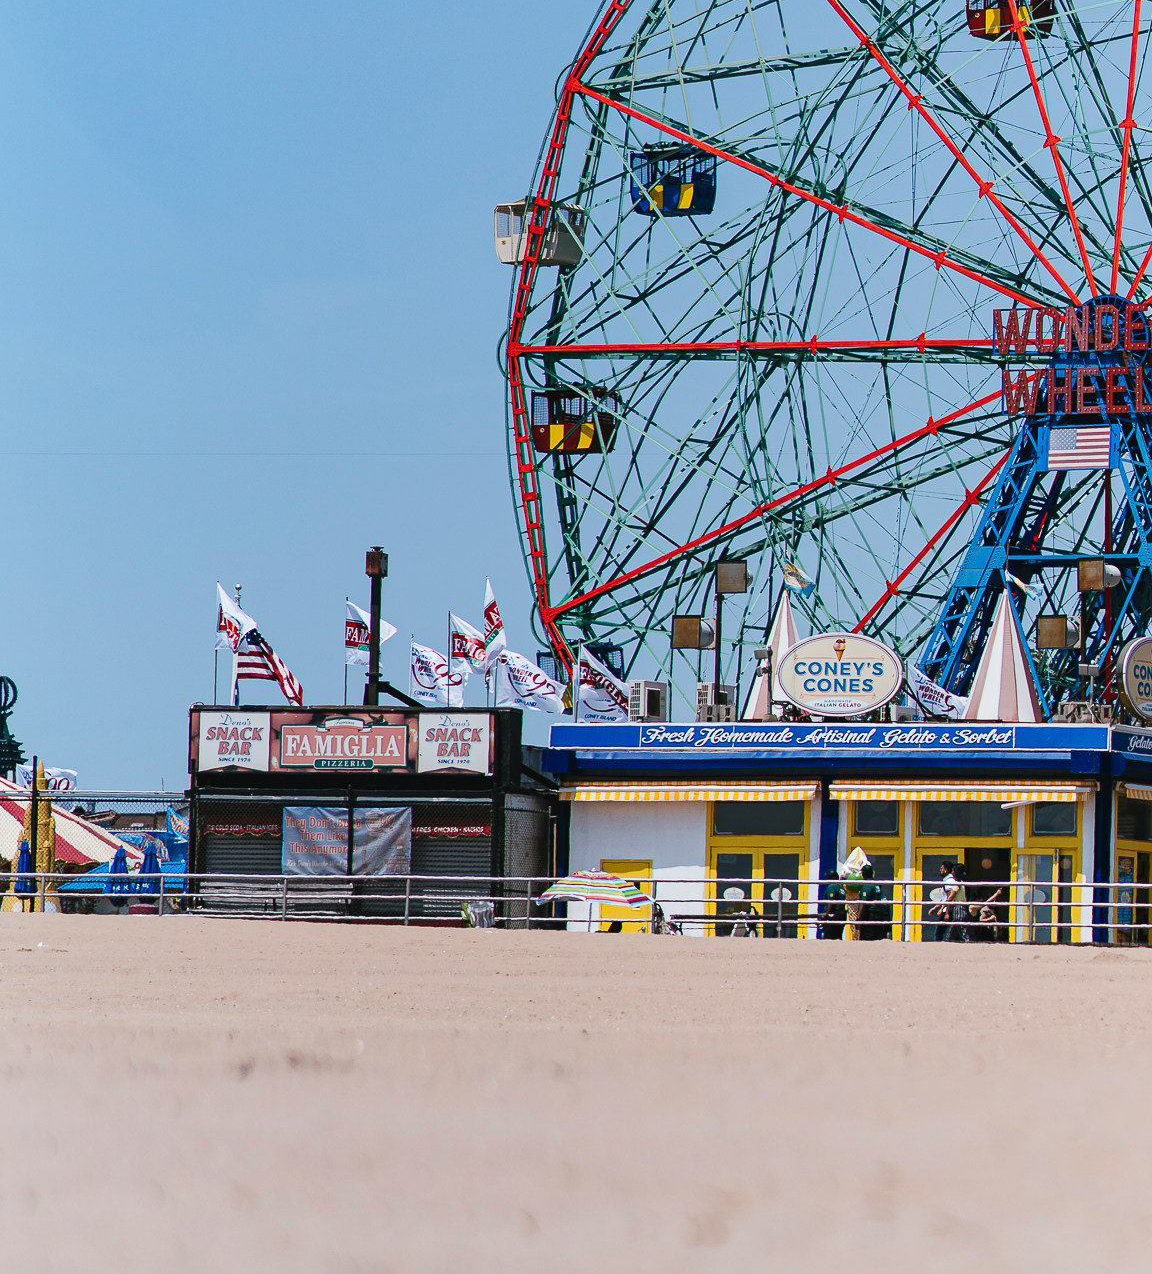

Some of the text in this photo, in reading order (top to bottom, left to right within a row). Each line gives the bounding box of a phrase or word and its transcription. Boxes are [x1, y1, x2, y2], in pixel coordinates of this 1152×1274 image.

[794, 662, 884, 676] CONEY'S
[803, 678, 875, 693] CONES
[219, 713, 251, 726] Deno's
[439, 714, 470, 726] Deno's
[206, 726, 264, 741] SNACK
[425, 727, 483, 742] SNACK
[642, 727, 1012, 748] Fresh Homemade Artisinal Gelato & Sorbet
[218, 741, 252, 755] BAR
[285, 734, 402, 757] FAMIGLIA
[437, 743, 471, 757] BAR
[1127, 735, 1152, 751] Gelato
[286, 817, 306, 830] They
[309, 817, 335, 829] Don't
[338, 818, 362, 829] Buld
[301, 830, 347, 841] Them Like
[290, 842, 309, 854] This
